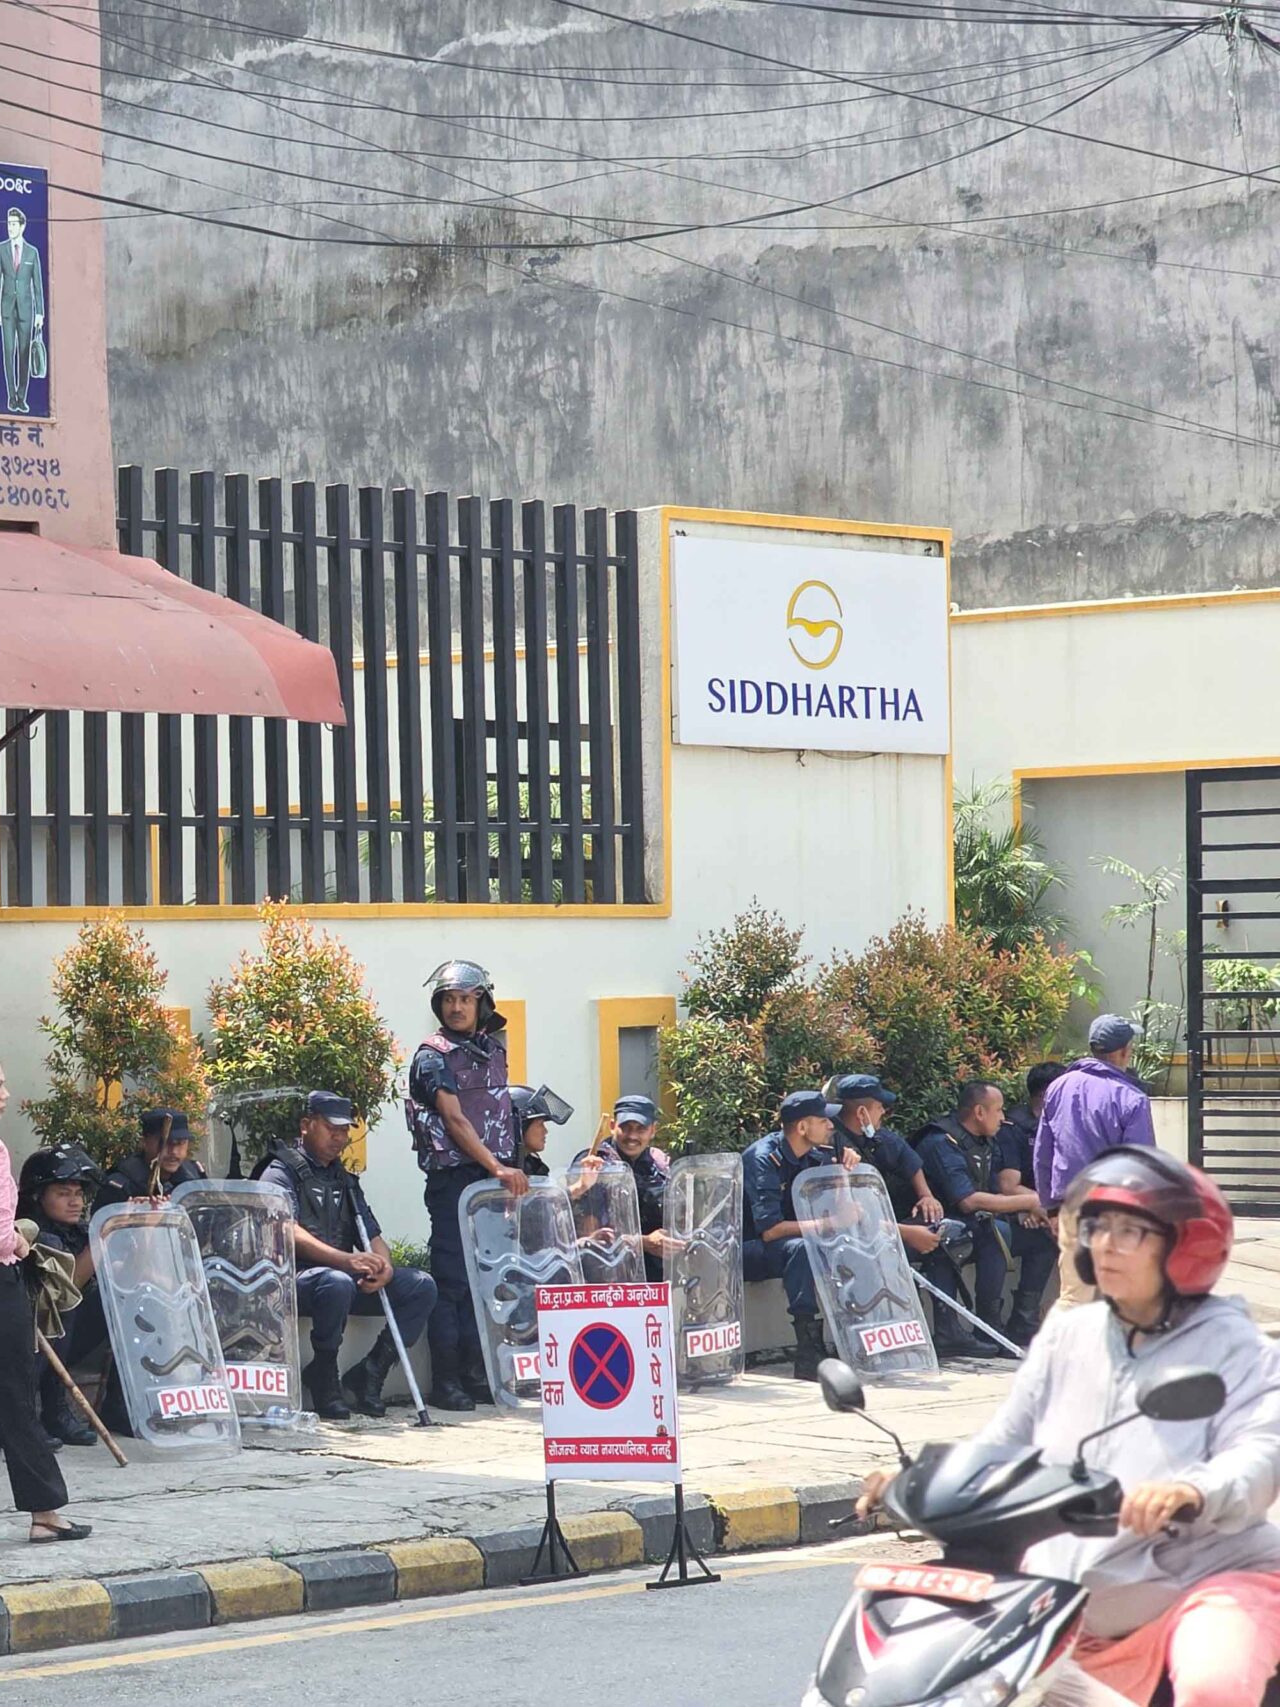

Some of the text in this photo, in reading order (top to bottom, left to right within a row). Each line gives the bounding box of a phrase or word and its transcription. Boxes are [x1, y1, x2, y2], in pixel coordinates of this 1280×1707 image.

[707, 677, 924, 722] SIDDHARTHA
[688, 1326, 740, 1355] POLICE
[863, 1323, 921, 1353] POLICE
[160, 1388, 229, 1415] POLICE
